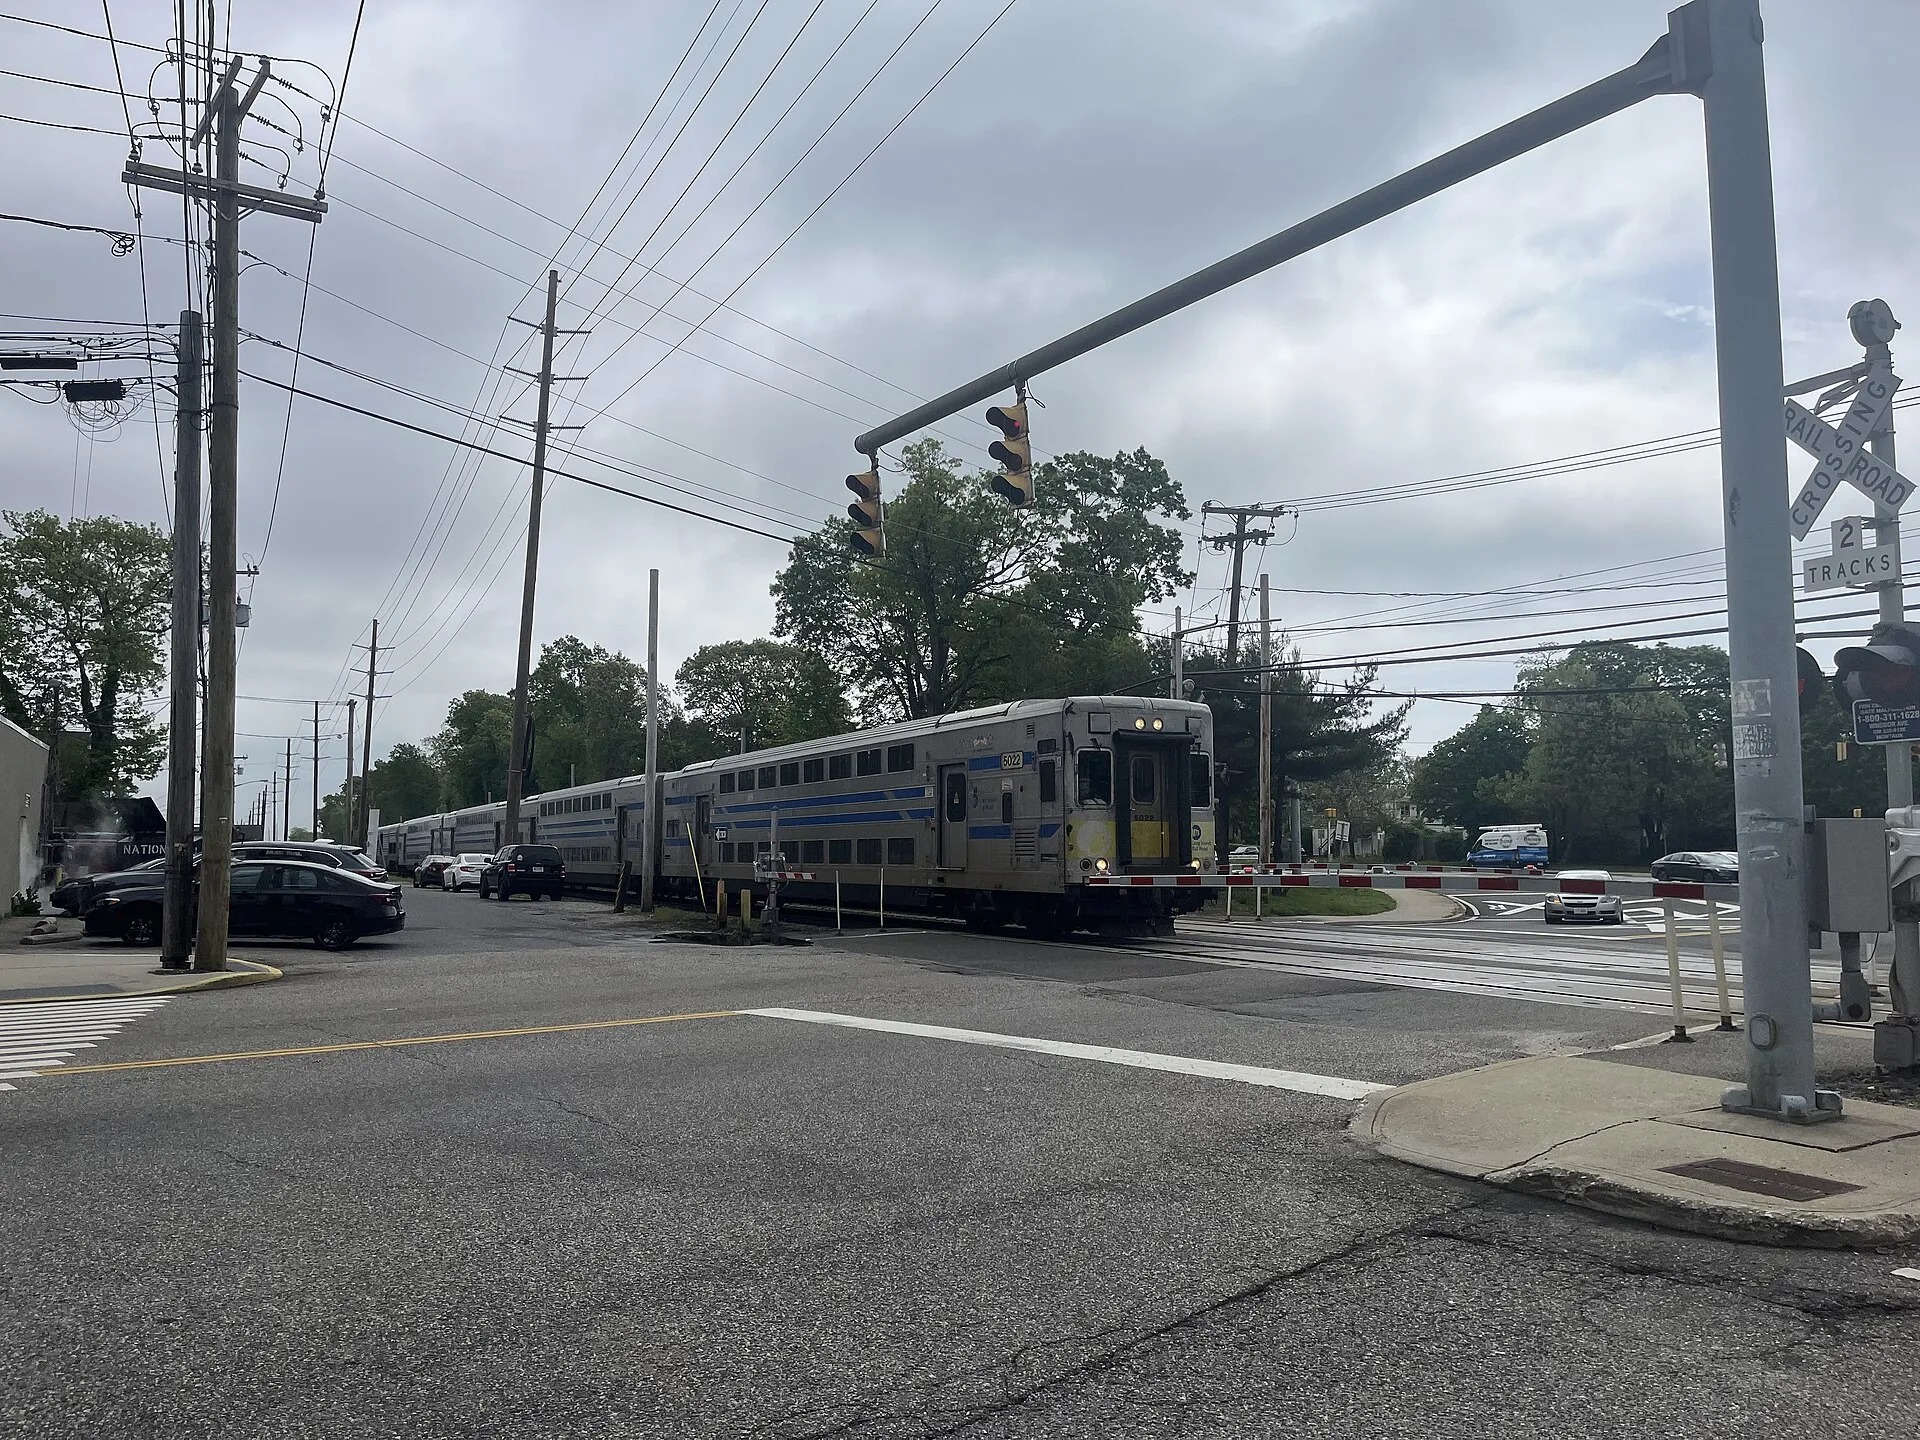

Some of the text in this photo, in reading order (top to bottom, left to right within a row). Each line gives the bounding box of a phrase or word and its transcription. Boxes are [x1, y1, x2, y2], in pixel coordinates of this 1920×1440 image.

[1784, 407, 1905, 505] RAIL ROAD
[1792, 380, 1887, 526] CROSSING
[1840, 521, 1854, 548] 2
[1808, 554, 1890, 584] TRACKS
[1857, 710, 1920, 723] 1-800-311-1628
[1003, 754, 1021, 767] 5022
